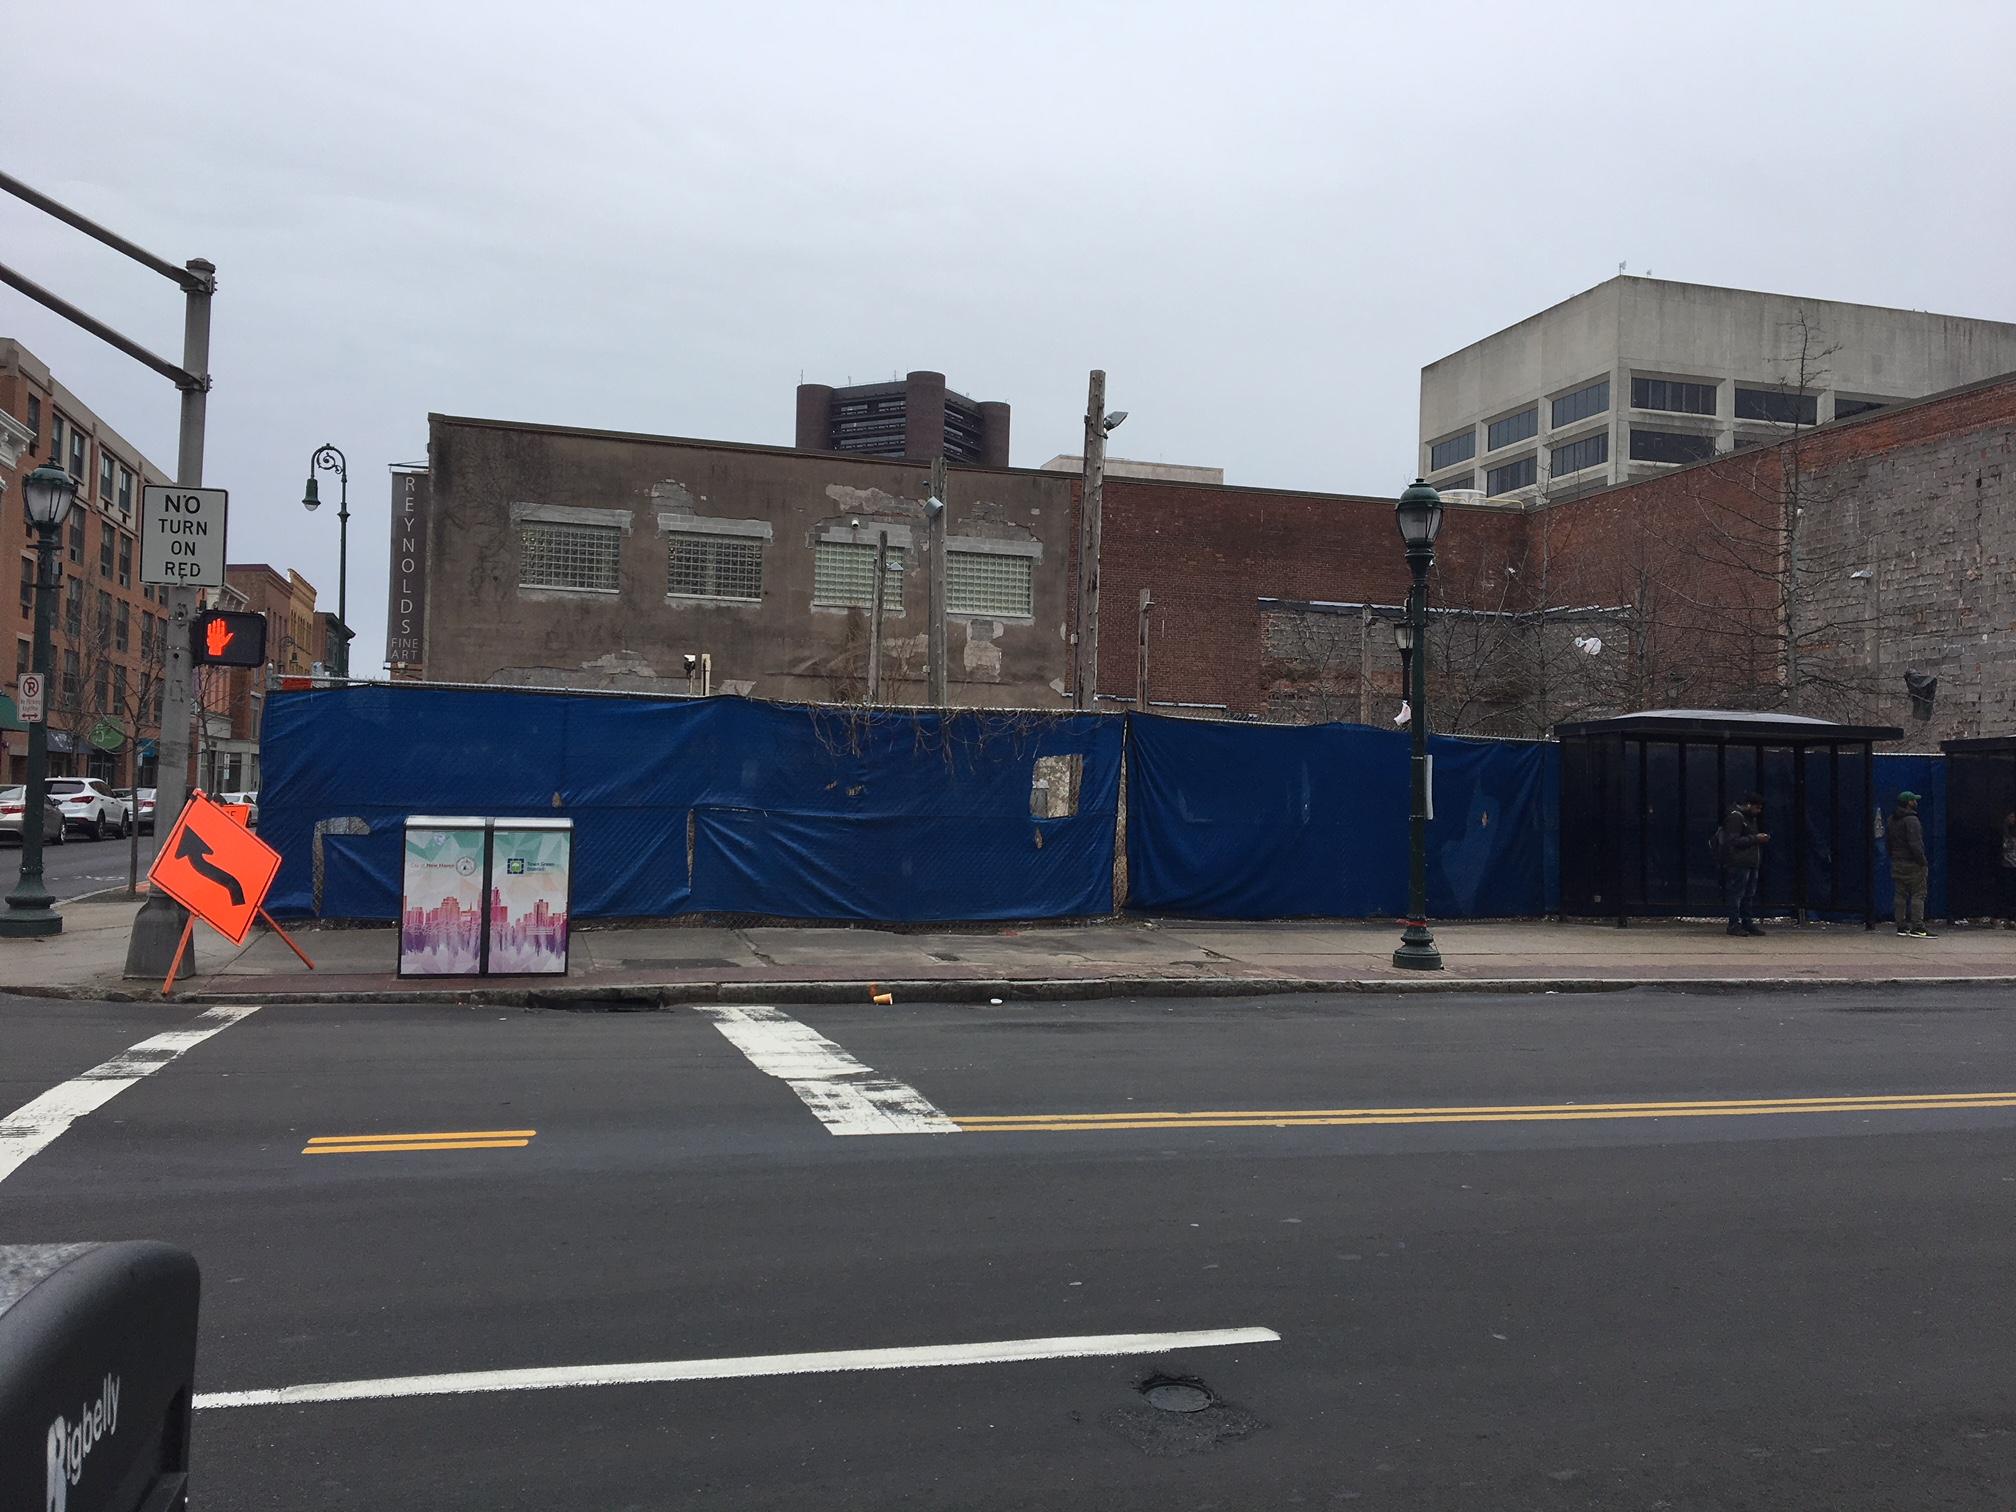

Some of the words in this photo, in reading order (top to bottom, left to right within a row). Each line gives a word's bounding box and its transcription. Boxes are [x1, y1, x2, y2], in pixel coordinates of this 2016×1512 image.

[164, 494, 201, 514] NO
[158, 518, 208, 536] TURN
[171, 540, 196, 556] ON
[400, 476, 415, 634] REYNOLDS
[164, 561, 201, 577] RED
[391, 637, 419, 649] FINE
[390, 650, 417, 660] ART
[46, 1372, 120, 1512] Bigbelly
